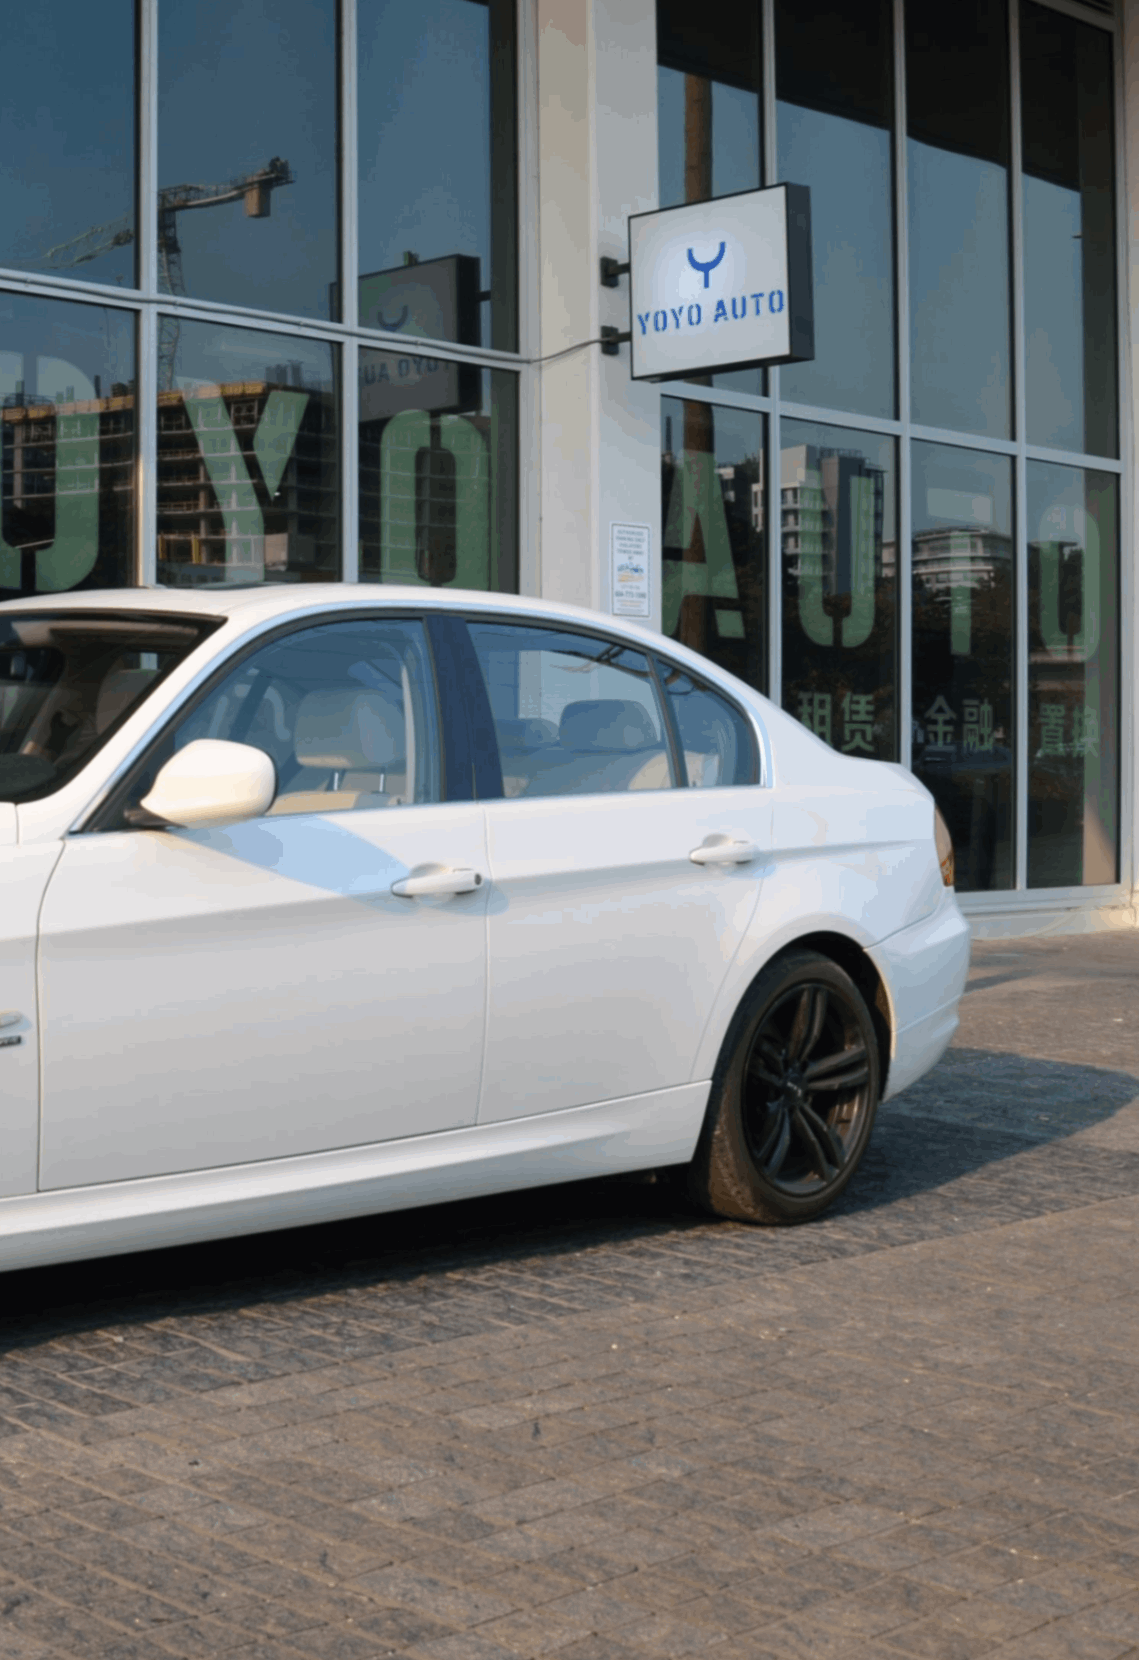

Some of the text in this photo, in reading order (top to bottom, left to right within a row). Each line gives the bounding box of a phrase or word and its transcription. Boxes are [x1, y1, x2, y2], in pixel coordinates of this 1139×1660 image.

[637, 289, 785, 336] YOYO AUTO
[797, 691, 875, 752] 租赁
[923, 694, 995, 754] 金融
